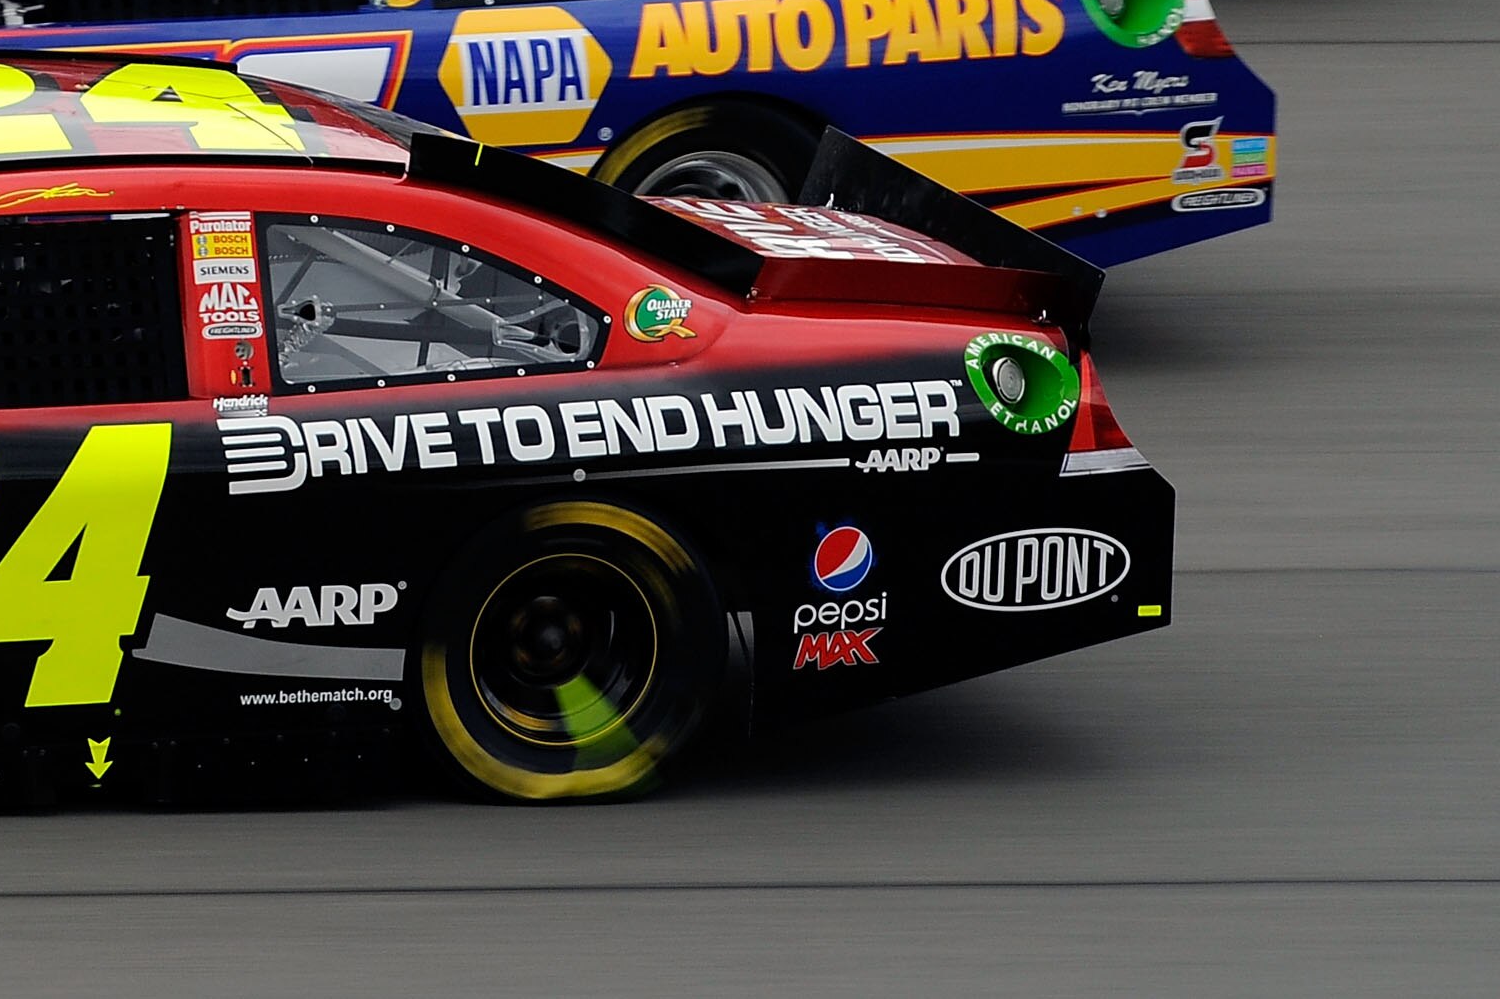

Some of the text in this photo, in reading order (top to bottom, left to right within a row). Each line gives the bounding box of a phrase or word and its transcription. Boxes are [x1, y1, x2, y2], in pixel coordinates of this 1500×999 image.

[468, 36, 586, 107] NAPA
[190, 219, 251, 234] Purolator
[213, 235, 248, 244] BOSCH
[214, 247, 249, 255] BOSCH
[200, 266, 249, 276] SIEMENS
[199, 282, 259, 313] MAC
[646, 298, 692, 312] QUAKER
[199, 311, 260, 324] TOOLS
[655, 307, 688, 321] STATE
[965, 332, 1056, 370] AMERICAN
[213, 393, 269, 411] Hendrick
[458, 403, 562, 463] TO
[560, 392, 701, 459] END
[703, 380, 961, 448] HUNGER
[990, 398, 1077, 434] ETHANOL
[855, 448, 941, 473] AARP
[959, 535, 1115, 603] DU PONT
[226, 583, 399, 629] AARP
[794, 591, 887, 634] pepsi
[793, 627, 884, 670] MAX
[240, 687, 392, 705] www.bethematch.org
